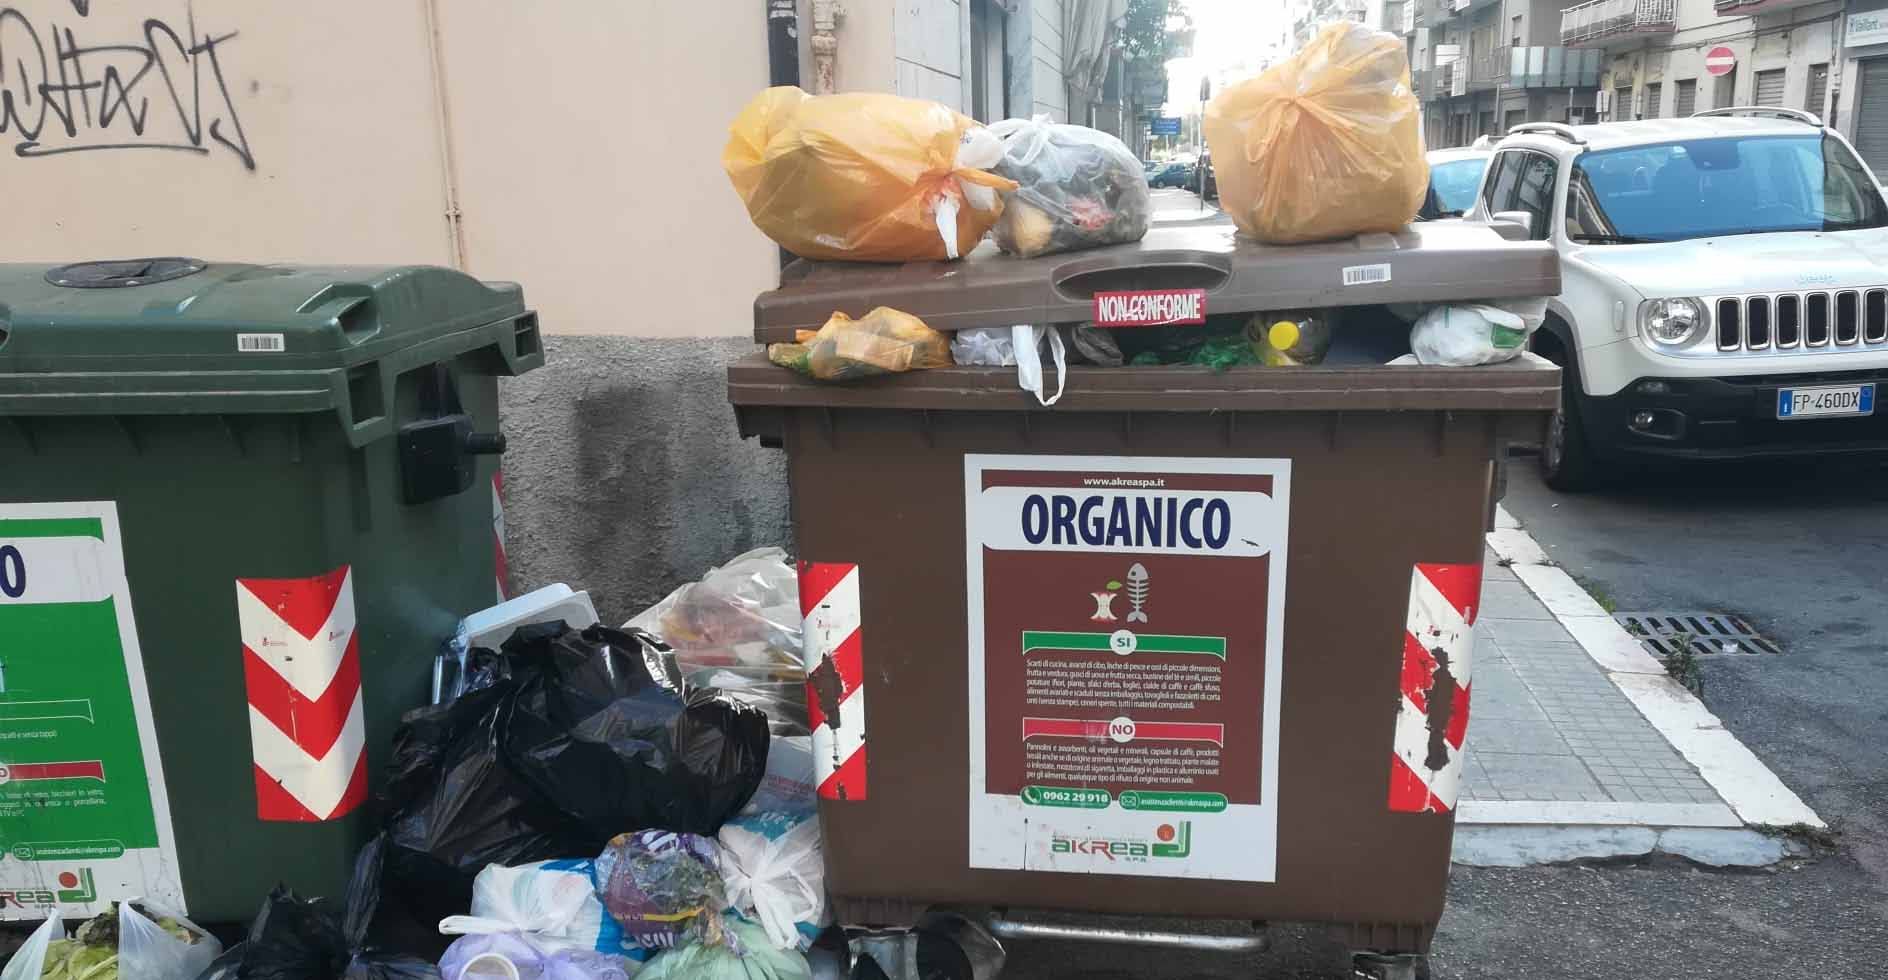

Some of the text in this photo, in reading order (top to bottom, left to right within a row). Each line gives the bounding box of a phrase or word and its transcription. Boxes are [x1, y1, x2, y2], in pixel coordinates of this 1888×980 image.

[1099, 293, 1201, 322] NON CONFORME
[1083, 477, 1166, 488] www.akreaspa.it
[1021, 494, 1231, 550] ORGANICO
[1116, 637, 1131, 648] SI
[1111, 725, 1134, 735] NO
[1043, 791, 1108, 803] 0962 29 918
